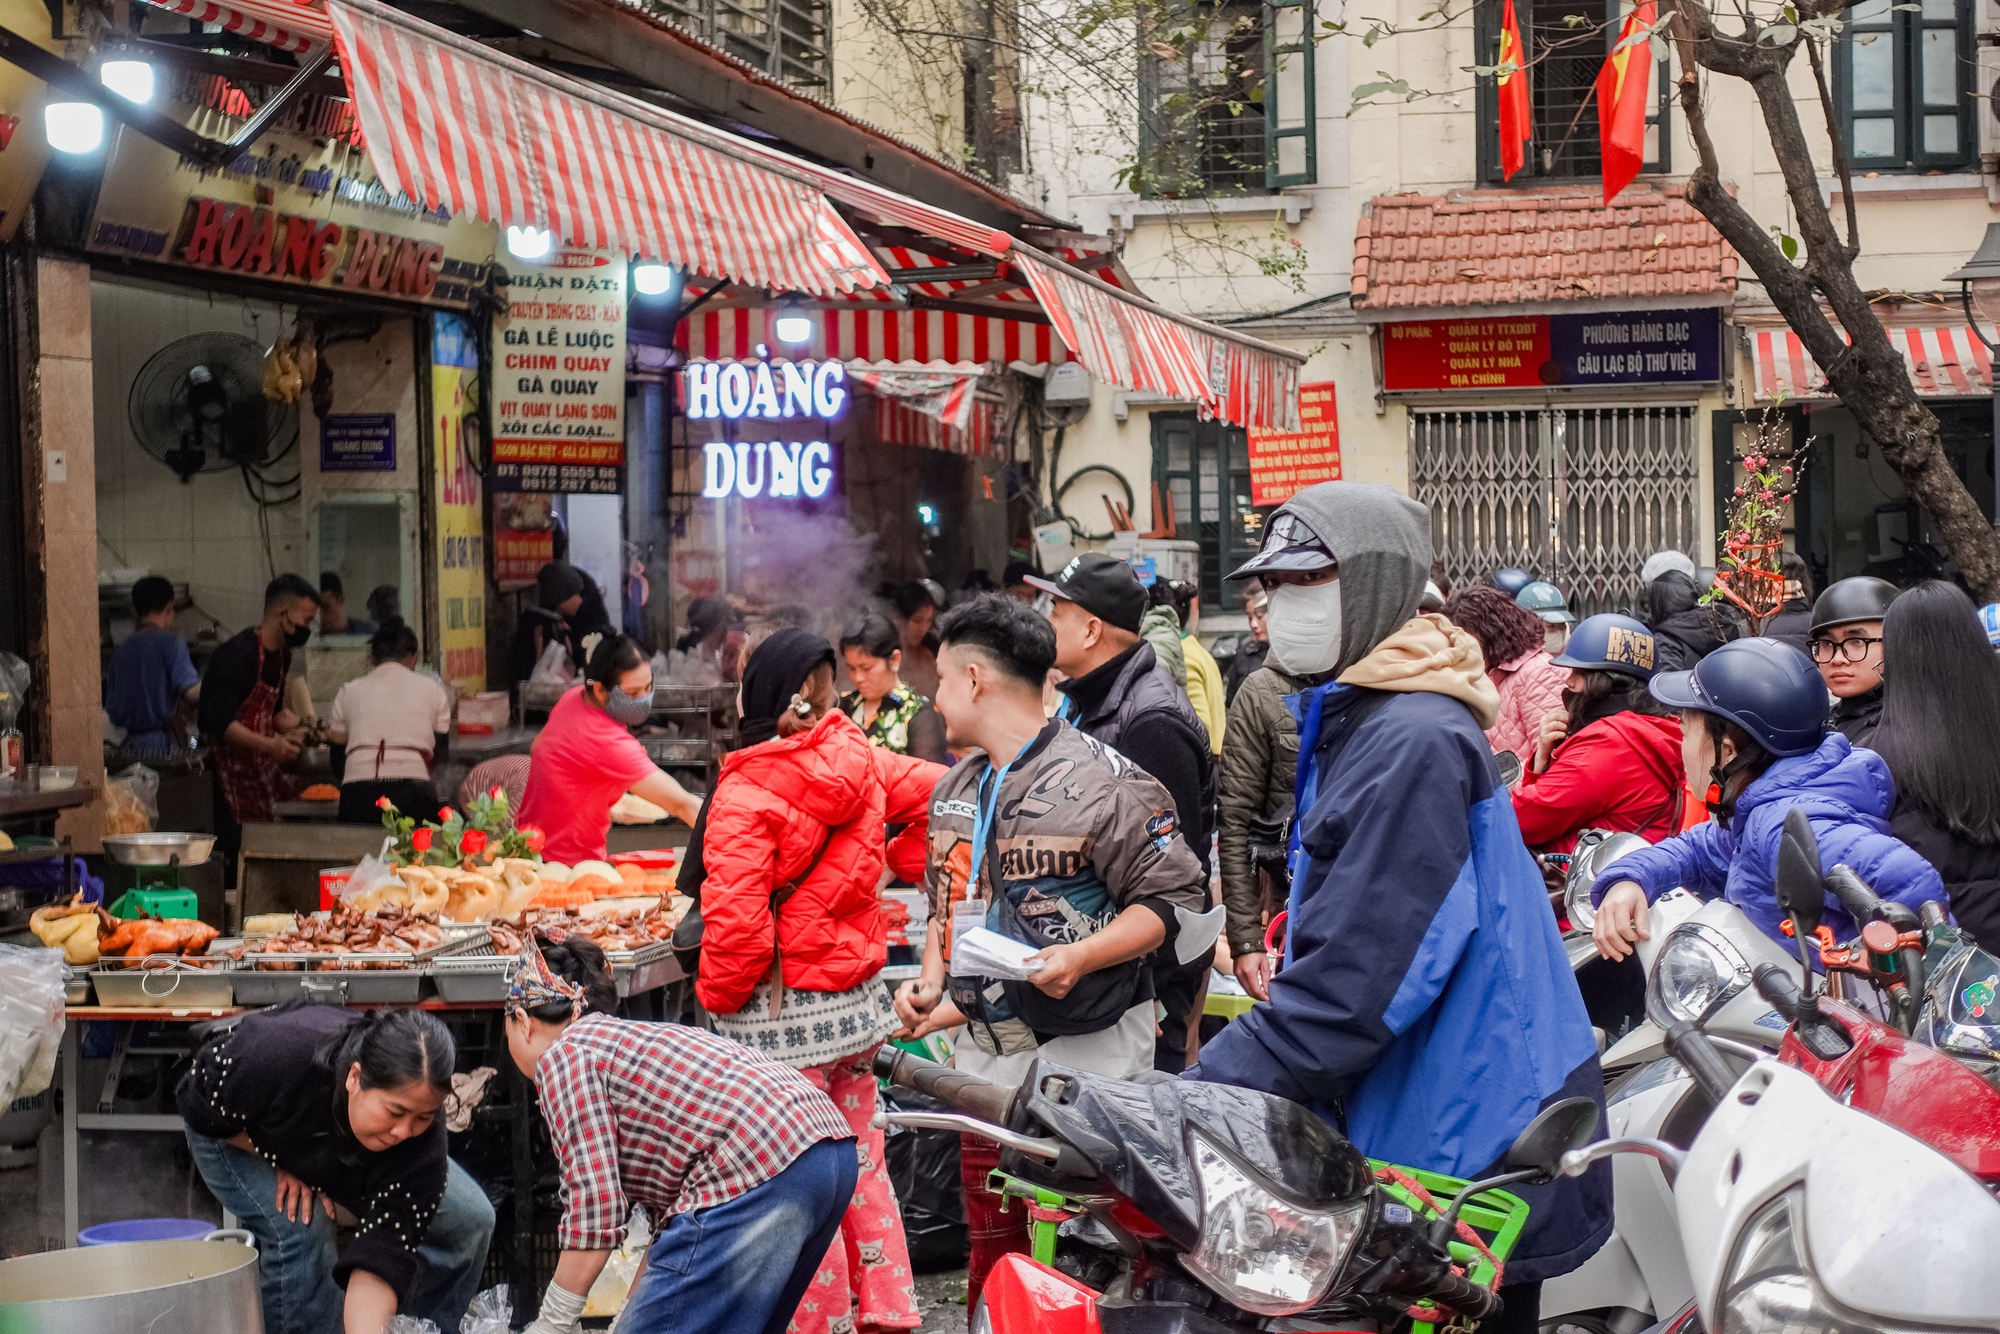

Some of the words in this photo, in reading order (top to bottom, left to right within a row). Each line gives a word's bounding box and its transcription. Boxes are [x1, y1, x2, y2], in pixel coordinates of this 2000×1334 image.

[185, 187, 342, 280] HOÀNG
[344, 228, 444, 297] DUNG
[507, 272, 564, 293] NHẬN
[504, 327, 530, 342] GÀ
[536, 325, 559, 342] LỄ
[565, 329, 615, 347] LUỘC
[1448, 321, 1479, 337] QUẢN
[1482, 323, 1495, 336] LÝ
[1582, 320, 1629, 345] PHƯỜNG
[1632, 320, 1664, 343] HÀNG
[1666, 322, 1690, 346] BẠC
[1449, 337, 1480, 354] QUẢN
[1482, 338, 1495, 352] LÝ
[1516, 340, 1534, 353] THỊ
[505, 353, 557, 371] CHIM
[564, 356, 612, 373] QUAY
[1450, 354, 1480, 370] QUẢN
[1483, 356, 1496, 368] LÝ
[1577, 351, 1600, 375] CÂU
[1603, 354, 1625, 378] LẠC
[1627, 350, 1643, 377] BỘ
[1645, 351, 1670, 373] THƯ
[1670, 348, 1697, 376] VIỆN
[518, 375, 544, 394] GÀ
[551, 379, 599, 396] QUAY
[687, 343, 846, 419] HOÀNG
[1450, 374, 1469, 388] ĐỊA
[1471, 371, 1506, 385] CHÍNH
[500, 401, 518, 421] VỊT
[521, 402, 552, 418] QUAY
[556, 403, 588, 421] LẠNG
[591, 403, 617, 420] SƠN
[501, 421, 528, 434] XÔI
[532, 420, 563, 435] CÁC
[361, 439, 384, 453] DUNG
[522, 465, 557, 478] 0978
[561, 466, 595, 478] 5555
[598, 467, 617, 480] 66
[702, 440, 833, 498] DUNG
[521, 477, 557, 490] 0912
